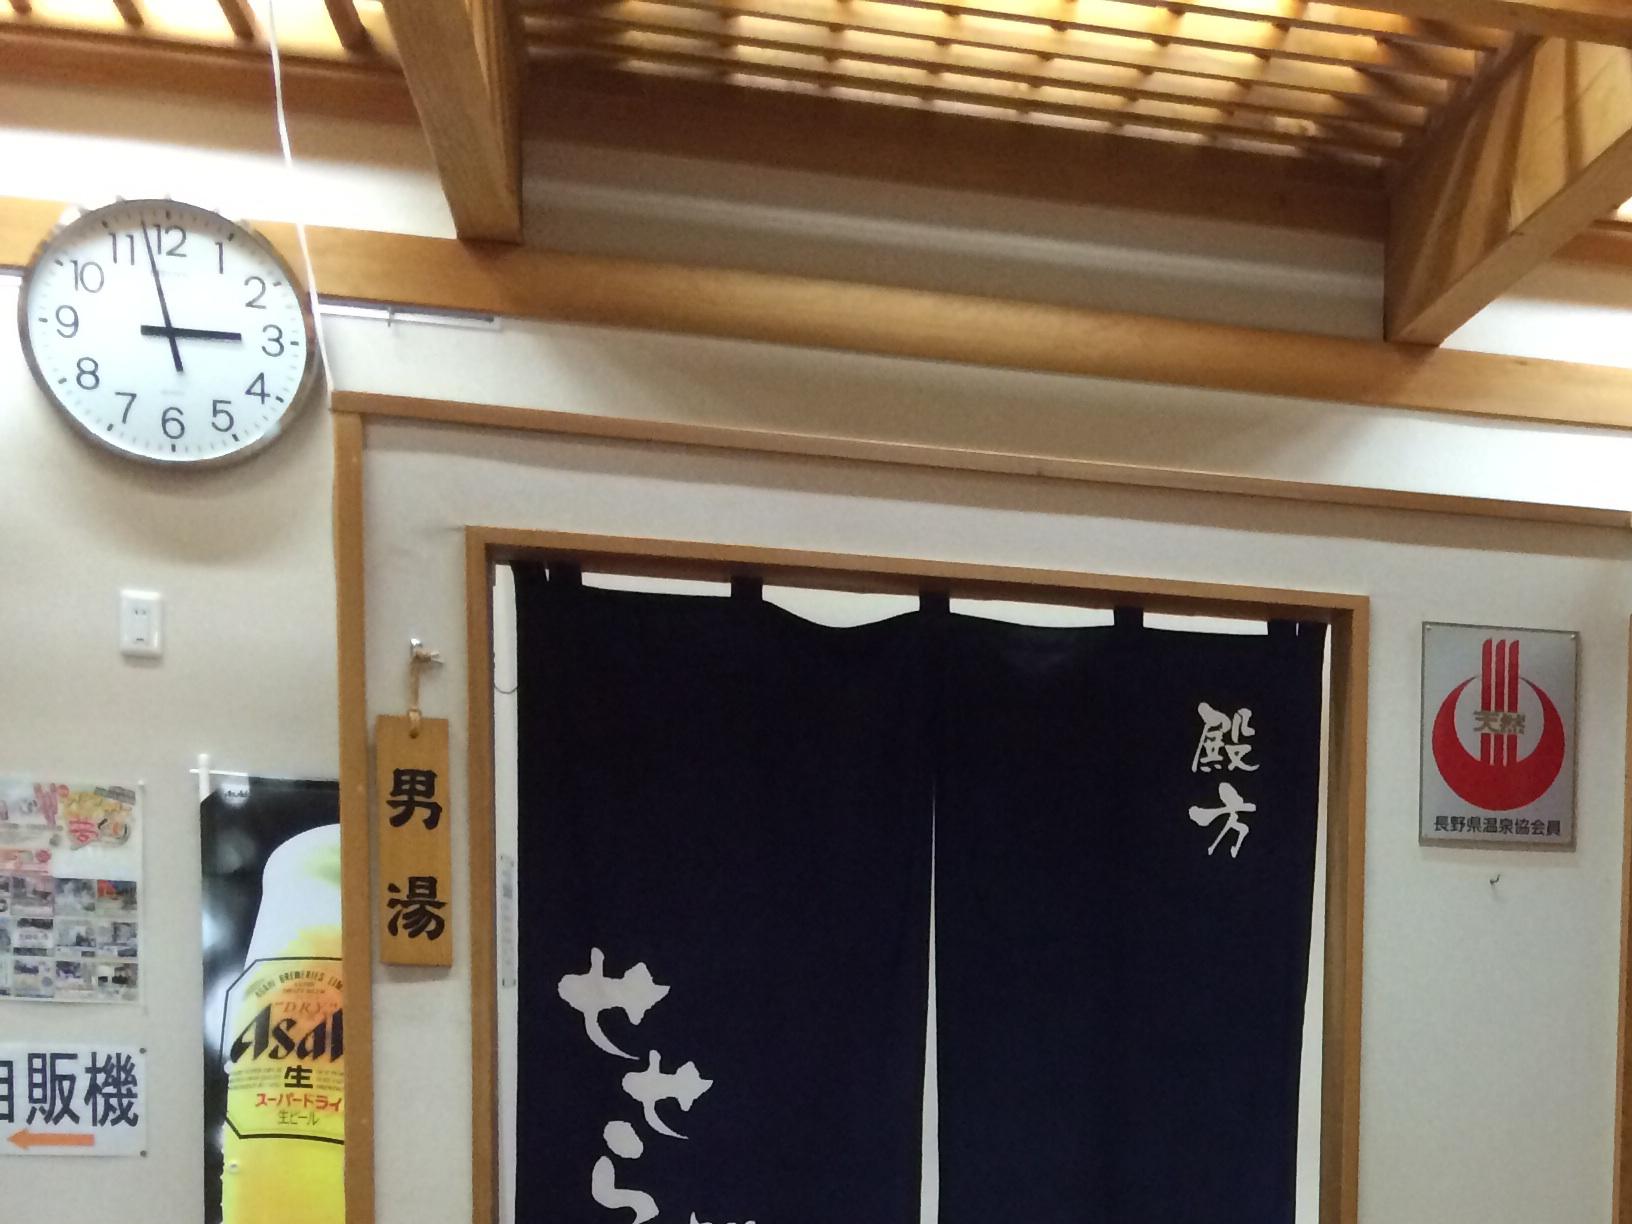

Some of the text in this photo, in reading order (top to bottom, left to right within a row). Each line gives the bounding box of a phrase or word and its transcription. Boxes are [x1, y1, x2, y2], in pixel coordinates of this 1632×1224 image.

[109, 232, 135, 266] 11
[154, 225, 187, 257] 12
[215, 241, 224, 274] 1
[71, 260, 104, 293] 10
[244, 276, 266, 309] 2
[55, 305, 79, 338] 9
[262, 324, 284, 357] 3
[76, 357, 100, 390] 8
[245, 372, 270, 404] 4
[115, 392, 137, 424] 7
[161, 406, 185, 439] 6
[211, 399, 234, 432] 5
[1189, 702, 1259, 858] 殿方
[1433, 815, 1561, 836] 長野県温泉協会員
[386, 768, 447, 940] 男湯
[283, 1065, 313, 1088] 生
